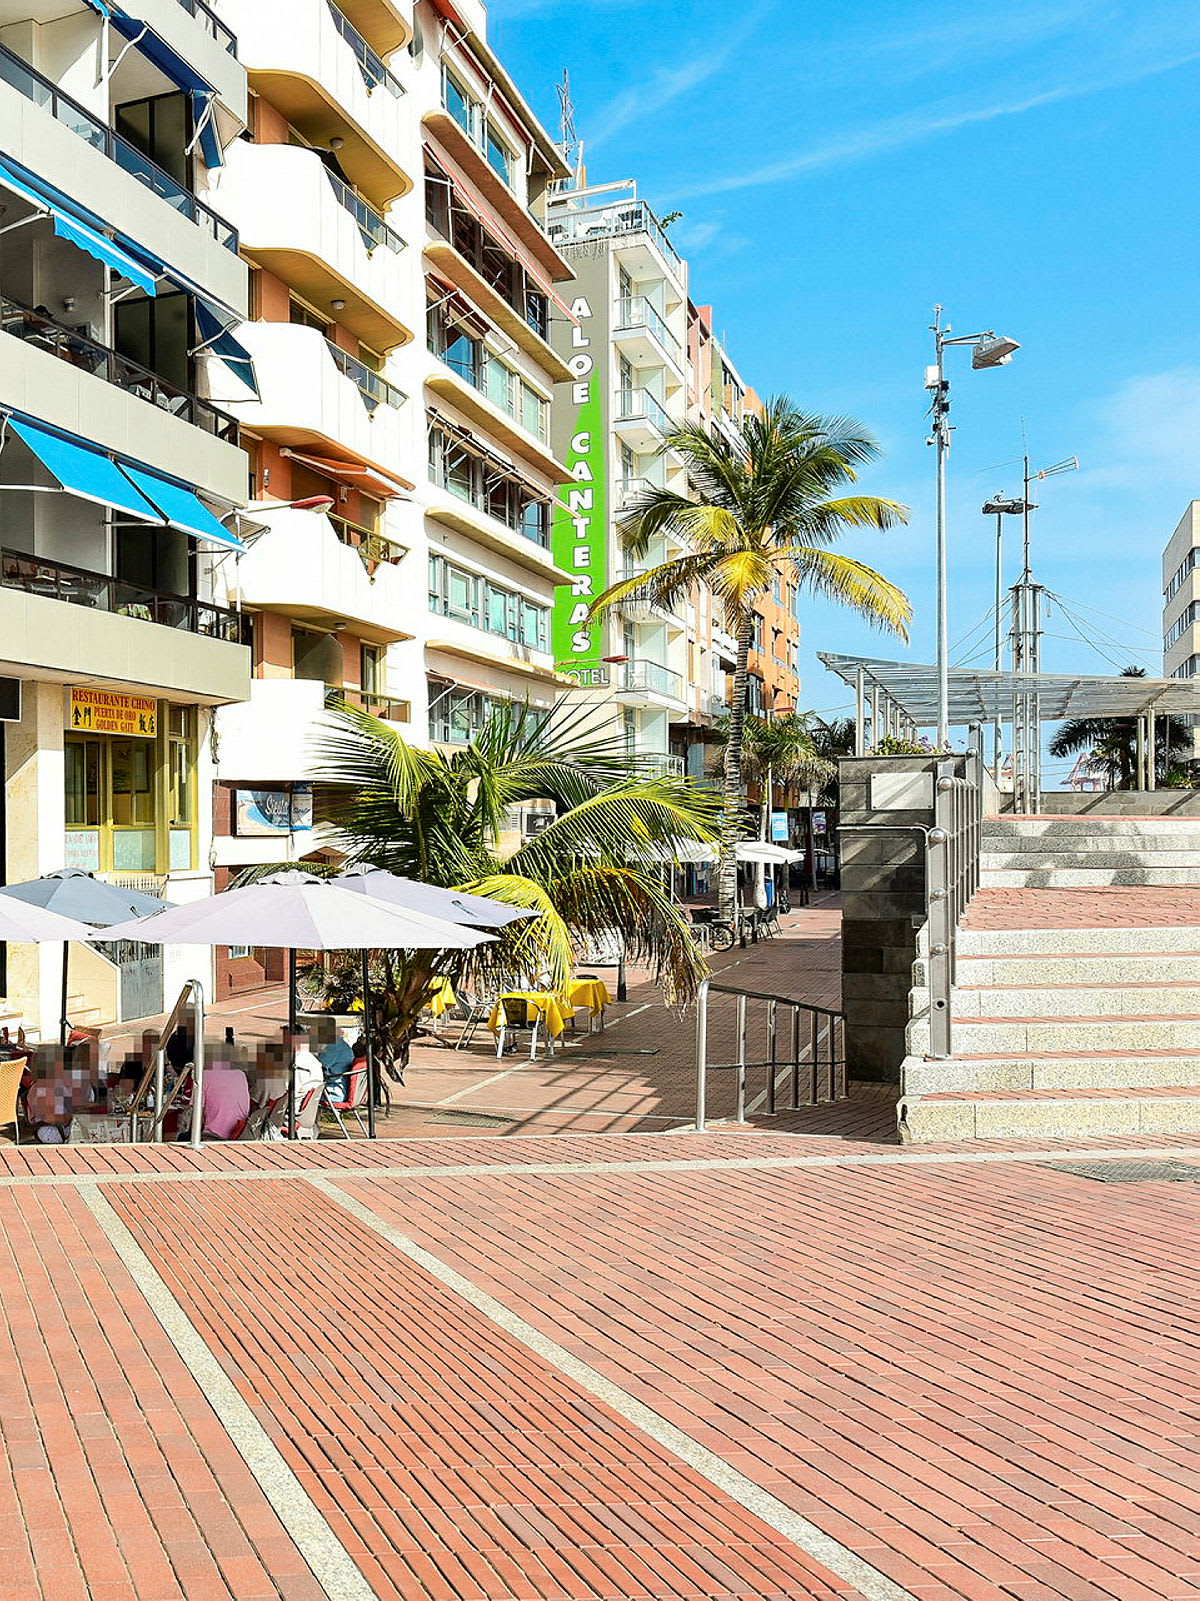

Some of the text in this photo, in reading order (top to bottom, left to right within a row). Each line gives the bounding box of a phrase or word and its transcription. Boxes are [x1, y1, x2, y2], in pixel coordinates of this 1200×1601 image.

[567, 296, 593, 405] ALOE
[568, 431, 594, 653] CANTERAS
[72, 689, 155, 711] RESTAURANTE CHINO
[94, 706, 136, 721] PUERTA DE ORO
[96, 719, 134, 732] GOLDEN GATE
